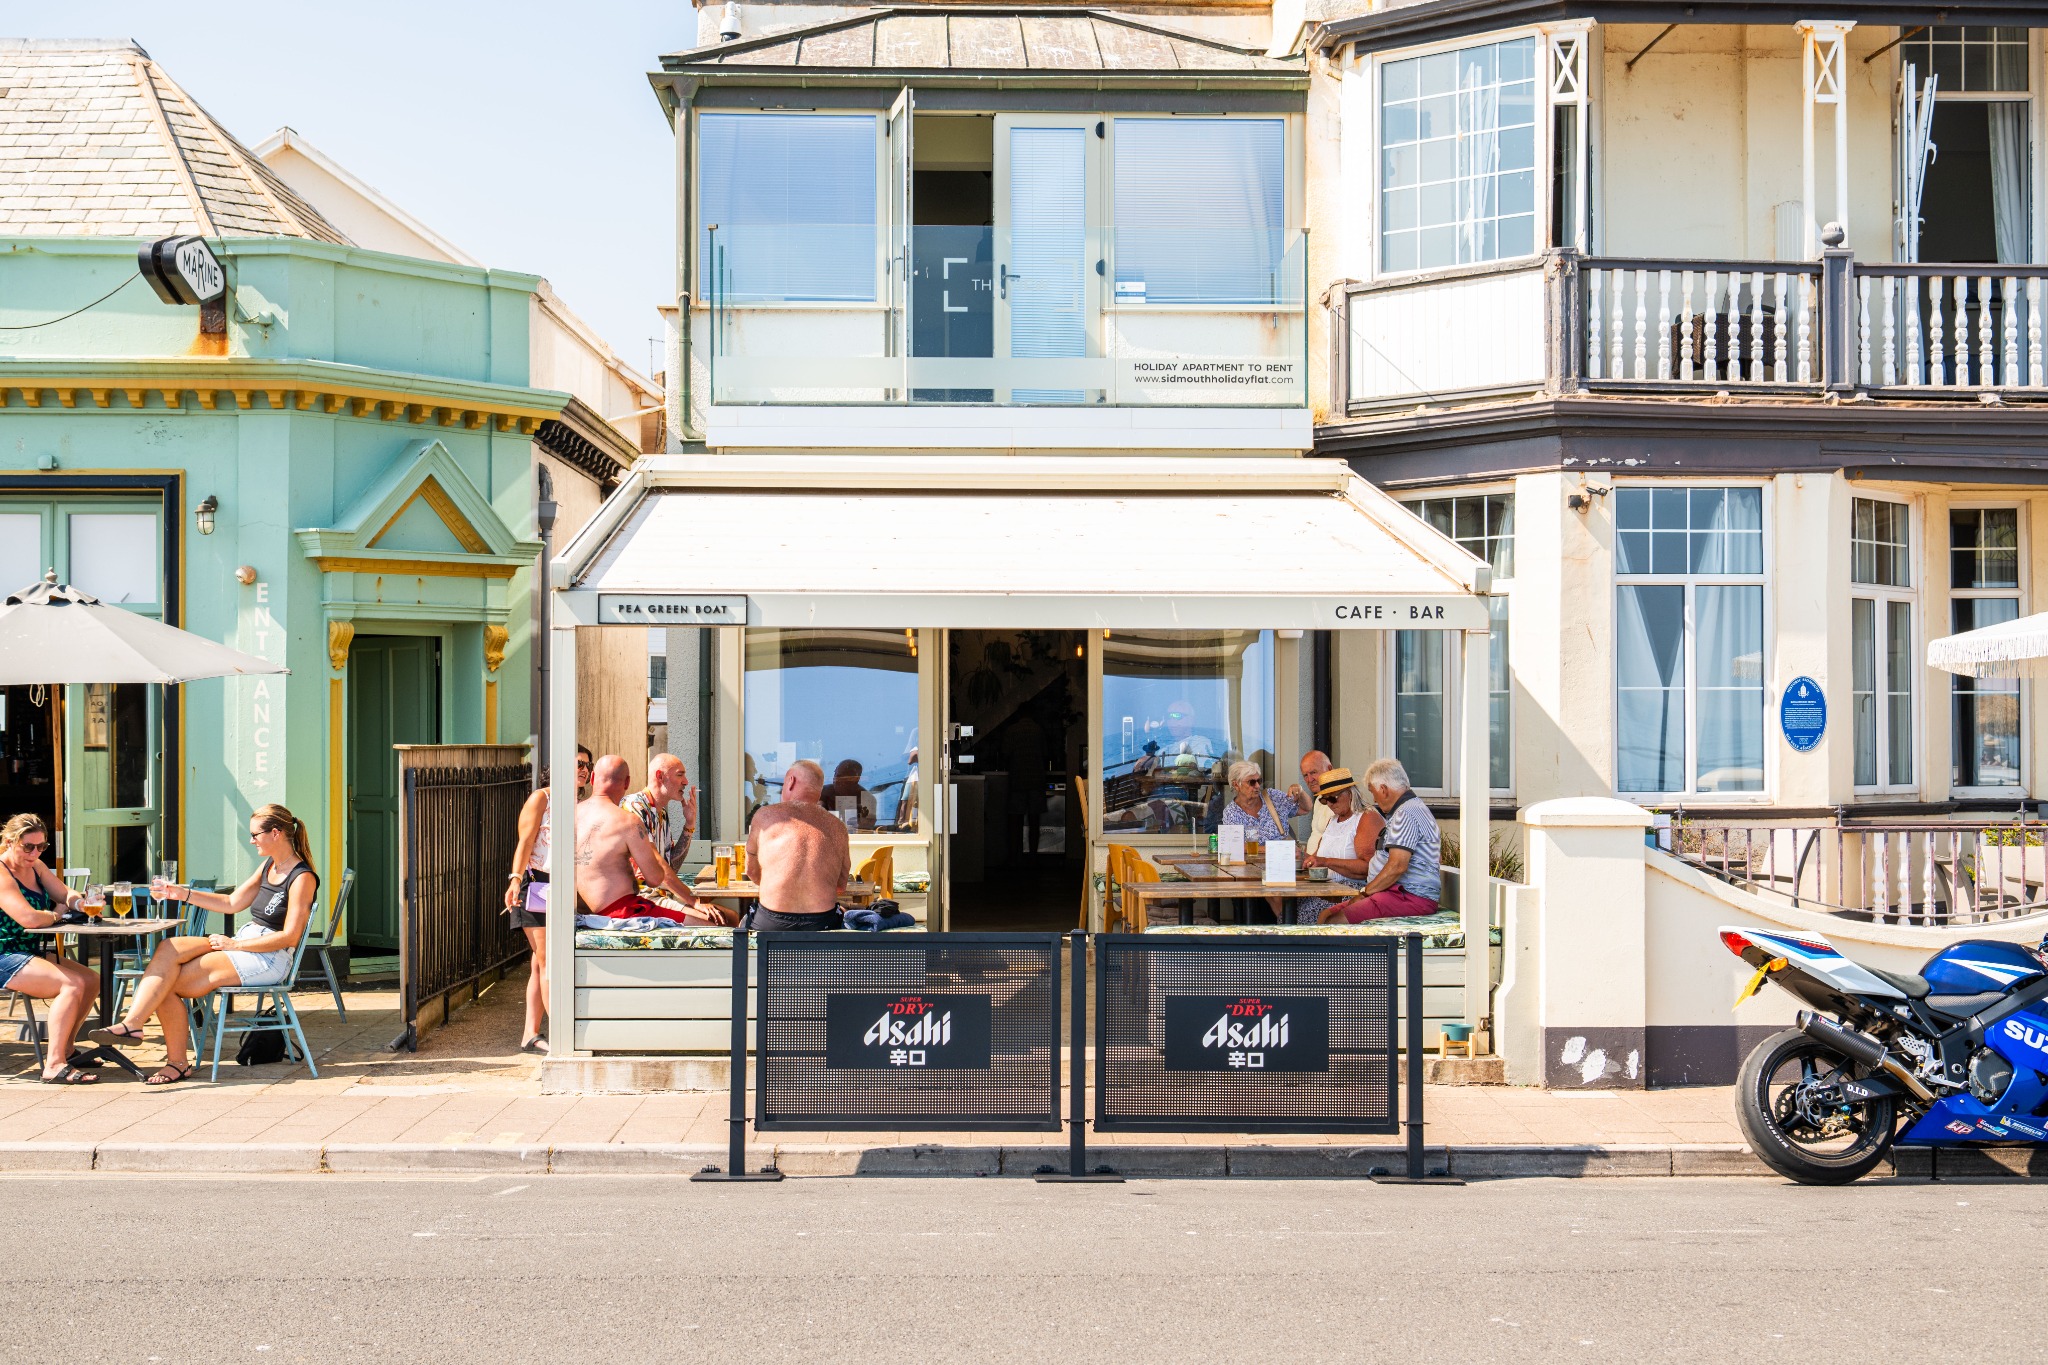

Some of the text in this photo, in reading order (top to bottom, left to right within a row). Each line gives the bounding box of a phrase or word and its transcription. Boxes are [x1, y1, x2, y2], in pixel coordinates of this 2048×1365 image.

[183, 249, 218, 293] MARINE
[971, 279, 992, 291] TH
[1134, 363, 1293, 372] HOLIDAY APARTMENT TO RENT
[1134, 374, 1294, 385] www.sidmouthholidayflat.com
[618, 604, 728, 614] PEA GREEN BOAT
[1335, 605, 1445, 619] CAFE BAR
[253, 582, 271, 772] ENTANCE
[863, 1010, 951, 1046] Asahi
[1202, 1013, 1289, 1048] Asahi
[889, 1048, 926, 1066] 辛口
[1228, 1050, 1264, 1068] 辛口
